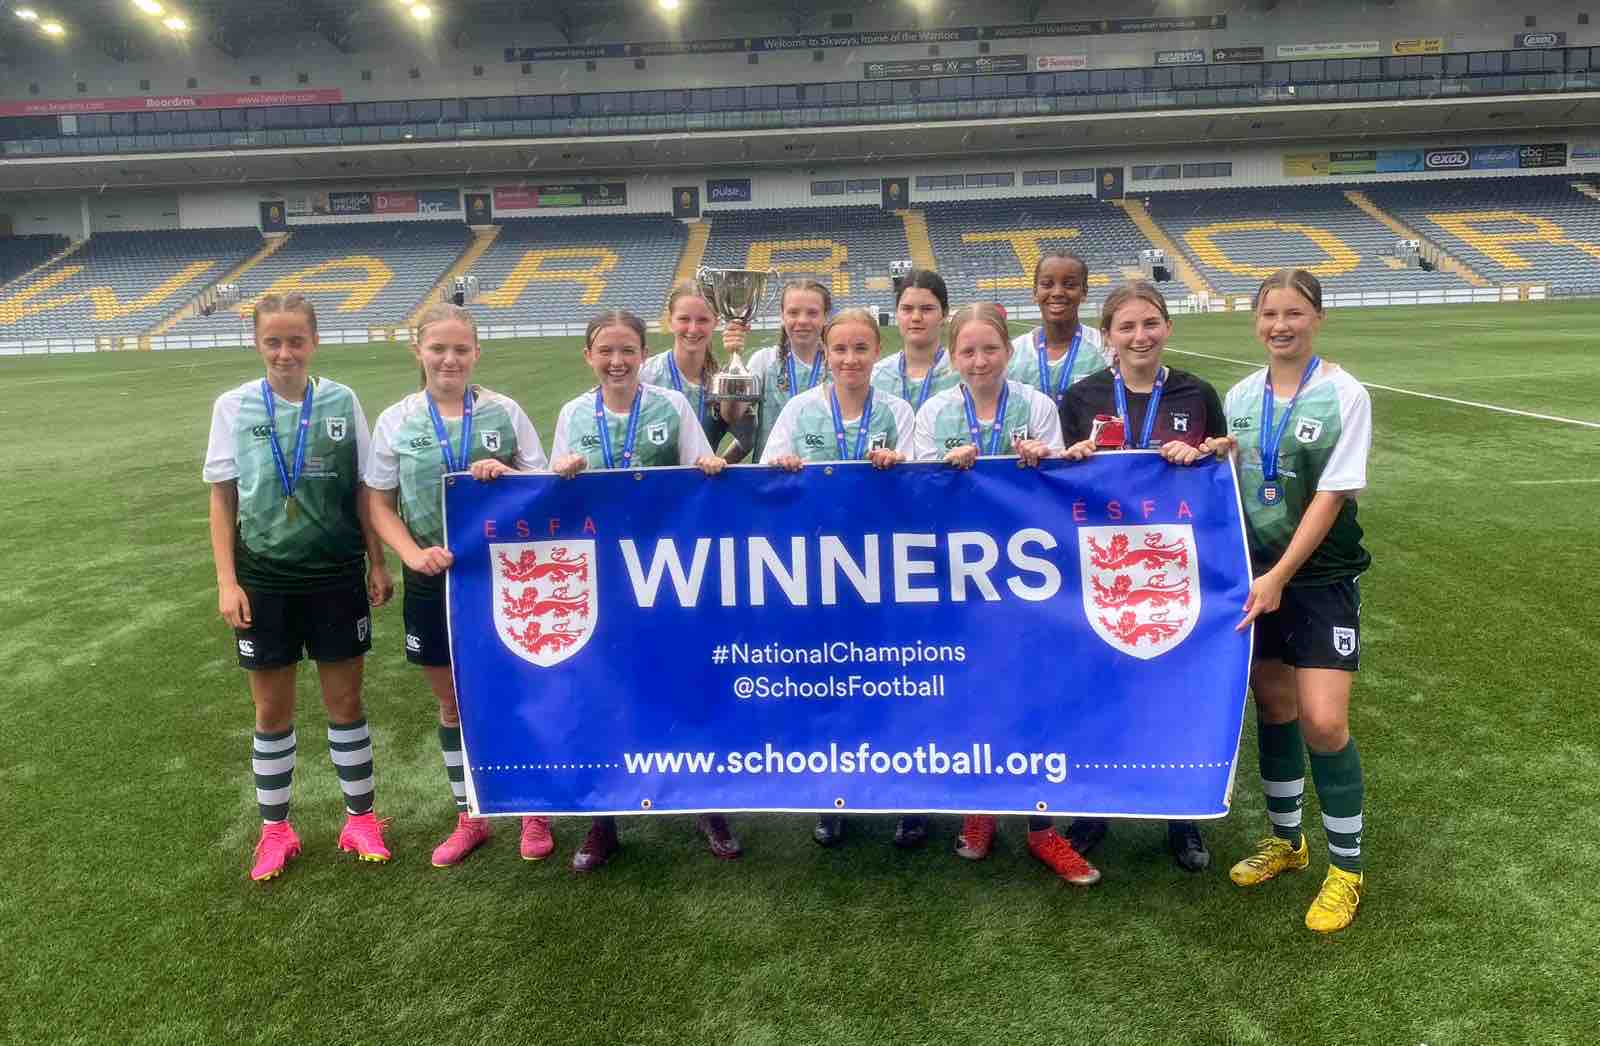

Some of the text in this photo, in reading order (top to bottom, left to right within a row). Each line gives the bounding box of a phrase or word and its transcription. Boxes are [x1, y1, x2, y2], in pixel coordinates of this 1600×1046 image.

[619, 527, 1063, 608] WINNERS
[711, 640, 967, 668] #NationalChampions
[733, 675, 945, 700] @SchoolsFootball
[623, 742, 1068, 784] www.schoolsfootball.org
